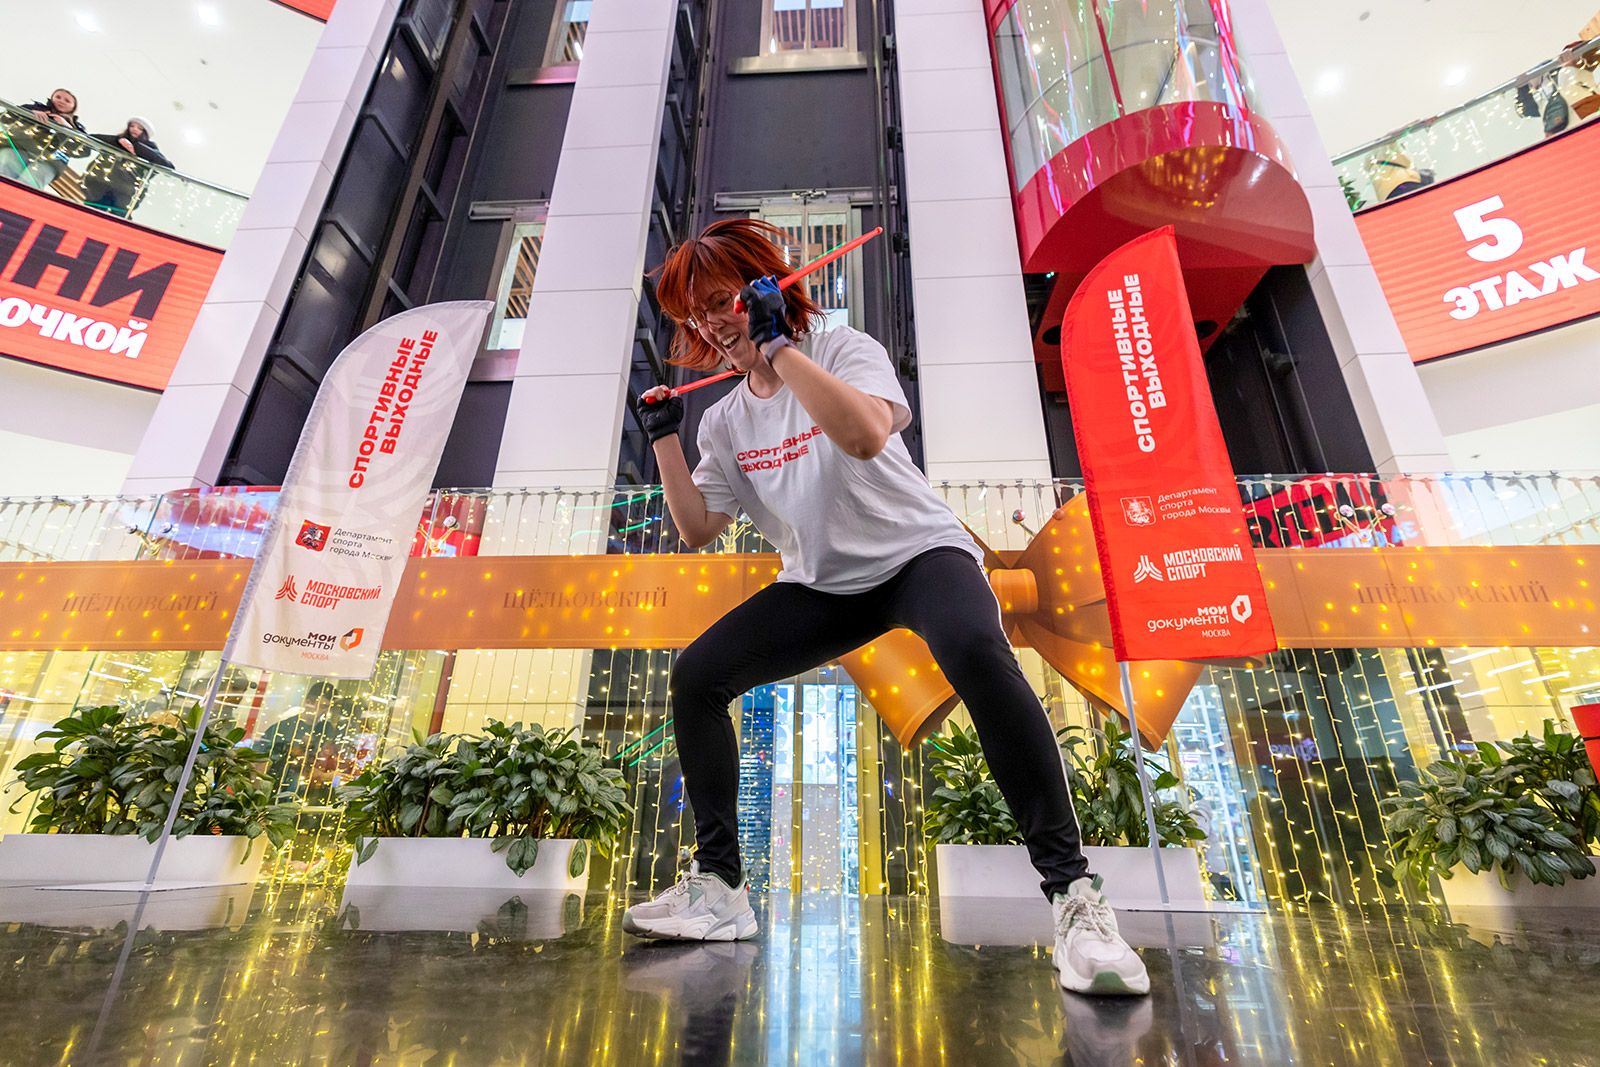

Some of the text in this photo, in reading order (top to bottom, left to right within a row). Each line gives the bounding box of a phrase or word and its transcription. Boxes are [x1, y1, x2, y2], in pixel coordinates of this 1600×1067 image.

[1453, 195, 1524, 262] 5
[1442, 247, 1600, 321] ЭТАЖ
[1124, 273, 1167, 409] ВЫХОДНЫЕ
[1107, 289, 1156, 453] СПОРТИВНЫЕ
[379, 330, 438, 454] ВЫХОДНЫЕ
[349, 337, 416, 488] СПОРТИВНЫЕ
[1157, 487, 1217, 503] Департамент
[1159, 499, 1194, 511] спорта
[1162, 509, 1196, 521] города
[329, 546, 360, 558] города
[332, 537, 363, 548] спорта
[1163, 544, 1243, 567] МОСКОВСКИЙ
[1166, 563, 1206, 581] СПОРТ
[305, 579, 382, 600] МОСКОВСКИЙ
[300, 592, 341, 610] СПОРТ
[1201, 629, 1231, 638] МОСКВА
